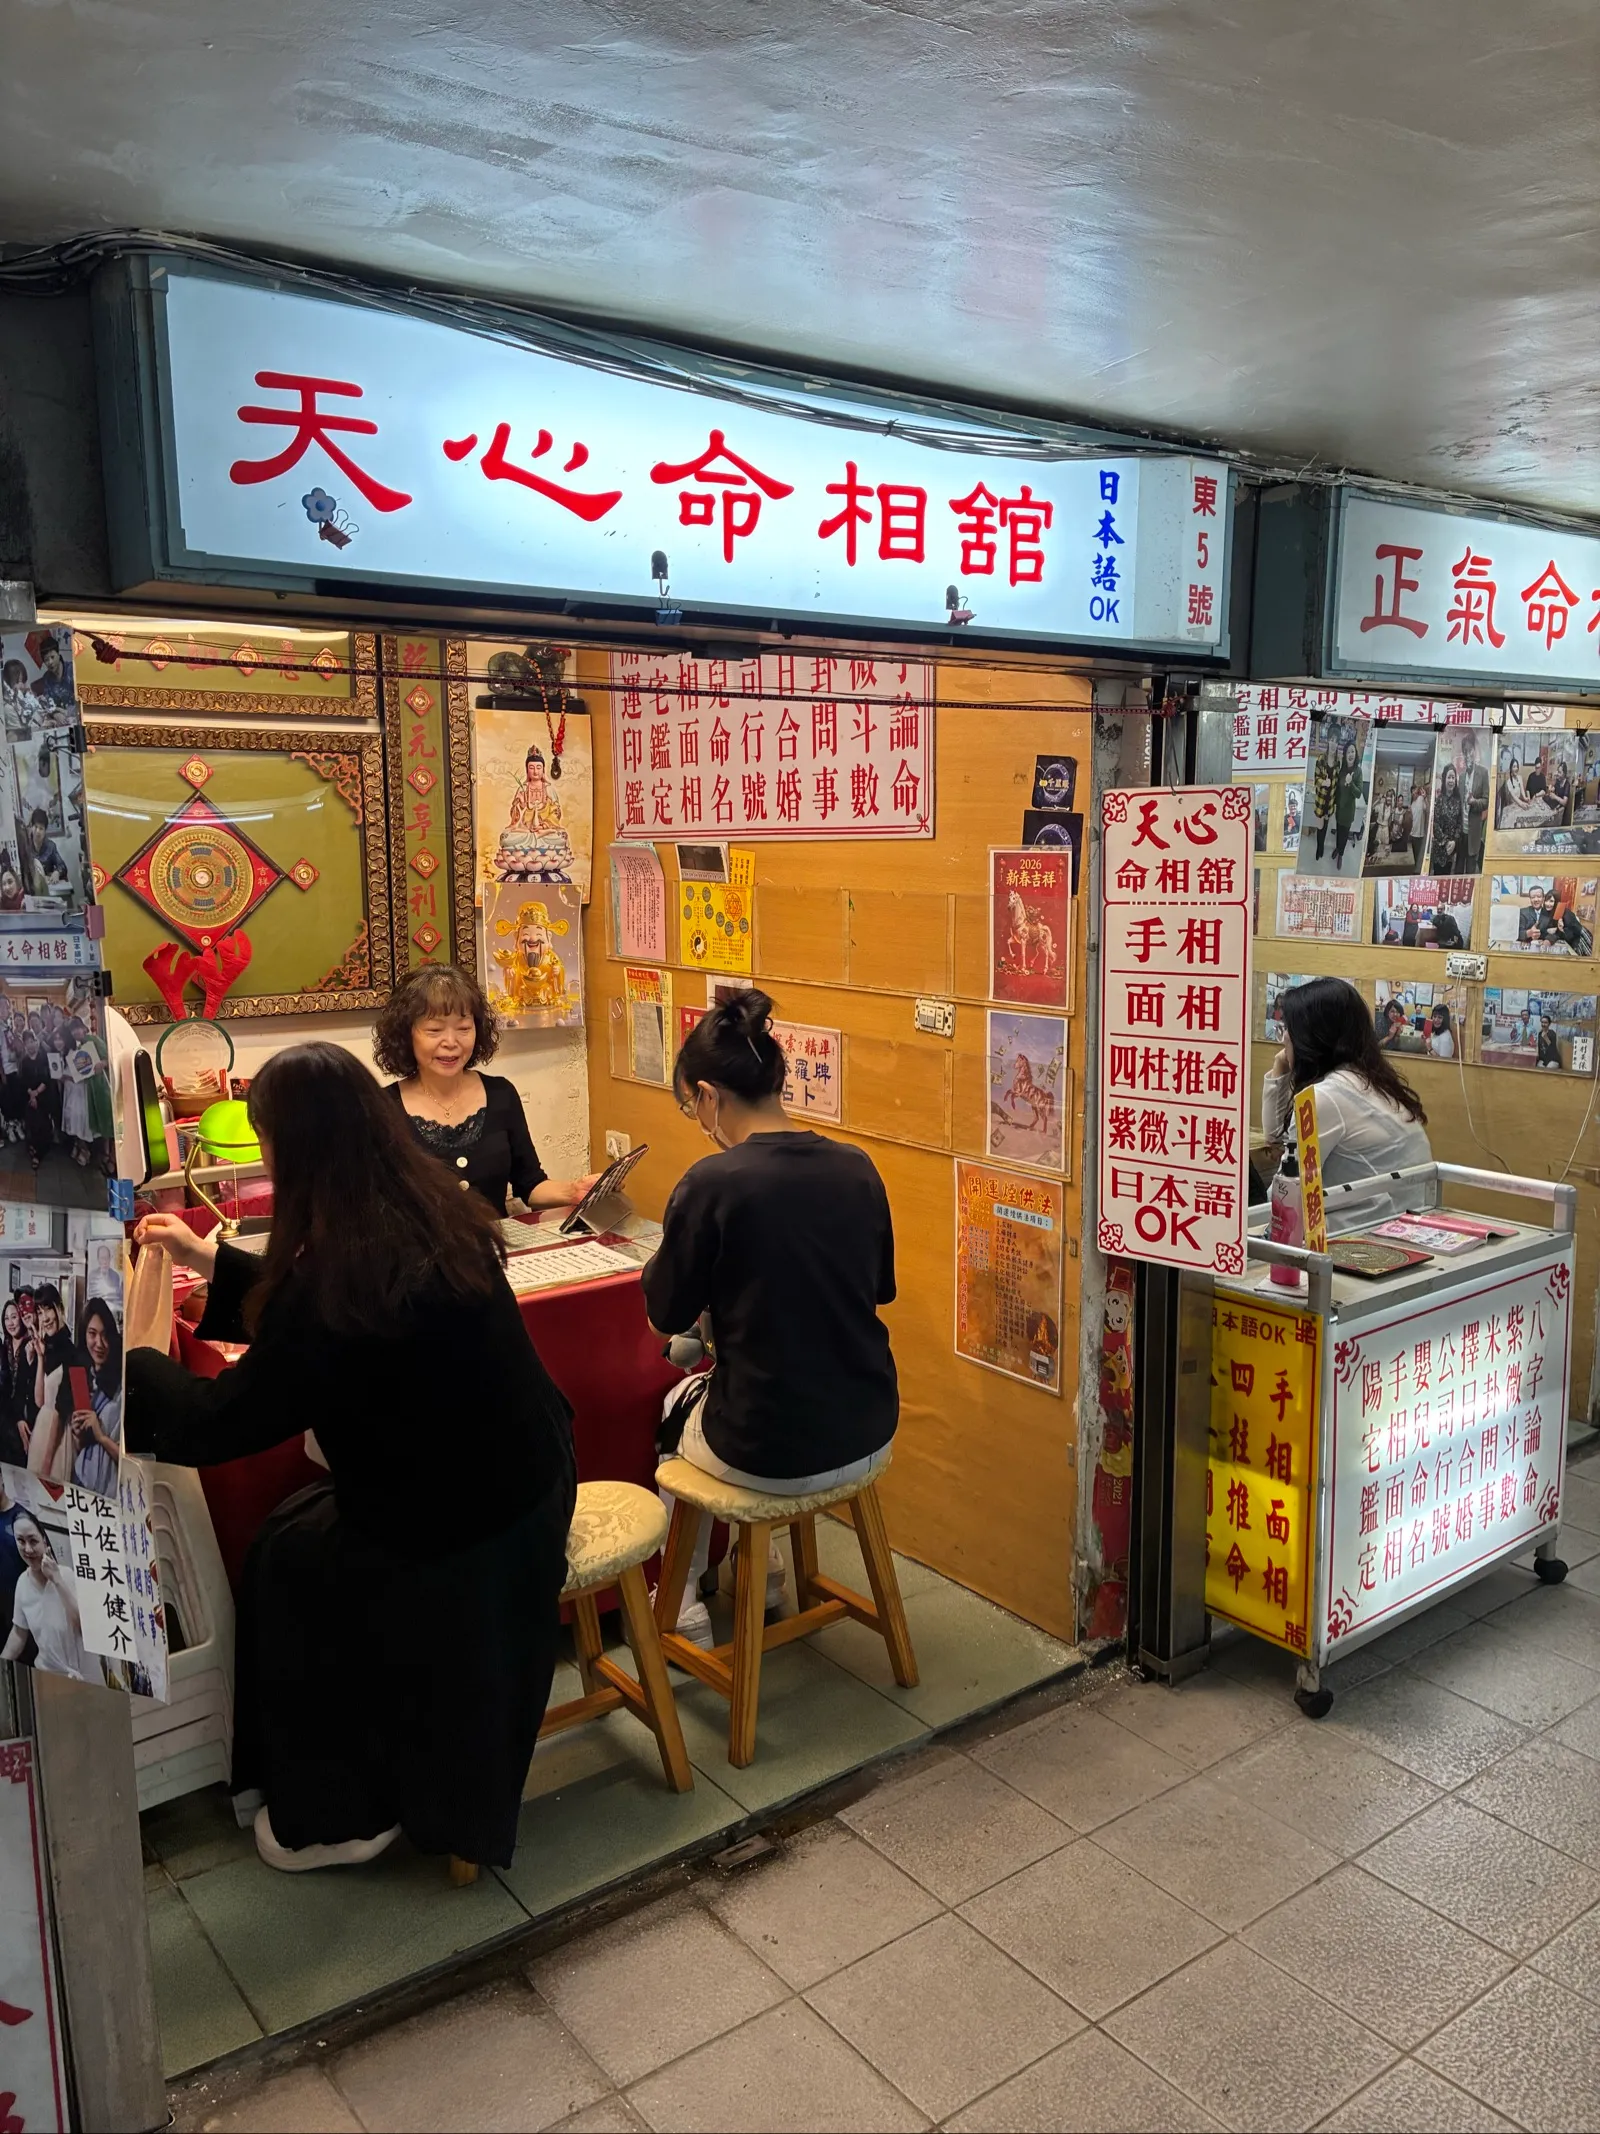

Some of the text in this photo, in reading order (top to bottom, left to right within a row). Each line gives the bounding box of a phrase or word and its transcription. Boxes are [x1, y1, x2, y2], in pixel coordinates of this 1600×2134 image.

[1186, 475, 1218, 627] 東5號
[1359, 544, 1600, 652] 正氣命
[647, 651, 673, 826] 宅鑑定
[1232, 684, 1251, 761] 宅鑑定
[1006, 869, 1056, 888] 新春吉祥
[1020, 859, 1042, 870] 2026
[1116, 857, 1237, 896] 命相舘
[1132, 799, 1219, 851] 天心
[1125, 915, 1223, 966] 手相
[1125, 981, 1223, 1032] 面相
[1110, 1045, 1238, 1100] 四柱推命
[1108, 1105, 1238, 1166] 紫微斗數
[1111, 1165, 1236, 1220] 日本語
[1134, 1205, 1203, 1252] OK
[1407, 1339, 1432, 1570] 嬰兒命名
[1431, 1332, 1457, 1557] 公司行號
[1454, 1320, 1481, 1542] 擇日合婚
[1478, 1314, 1501, 1531] 米卦問事
[1500, 1304, 1525, 1516] 紫微斗數
[1521, 1299, 1545, 1507] 八字論命
[1112, 1478, 1124, 1506] 2021
[1224, 1358, 1256, 1595] 四柱推命
[1262, 1368, 1295, 1611] 手相面相
[1357, 1360, 1382, 1598] 陽宅鑑定
[1382, 1350, 1408, 1585] 手相面相
[66, 1487, 97, 1582] 北斗晶
[91, 1495, 133, 1655] 佐佐木健介
